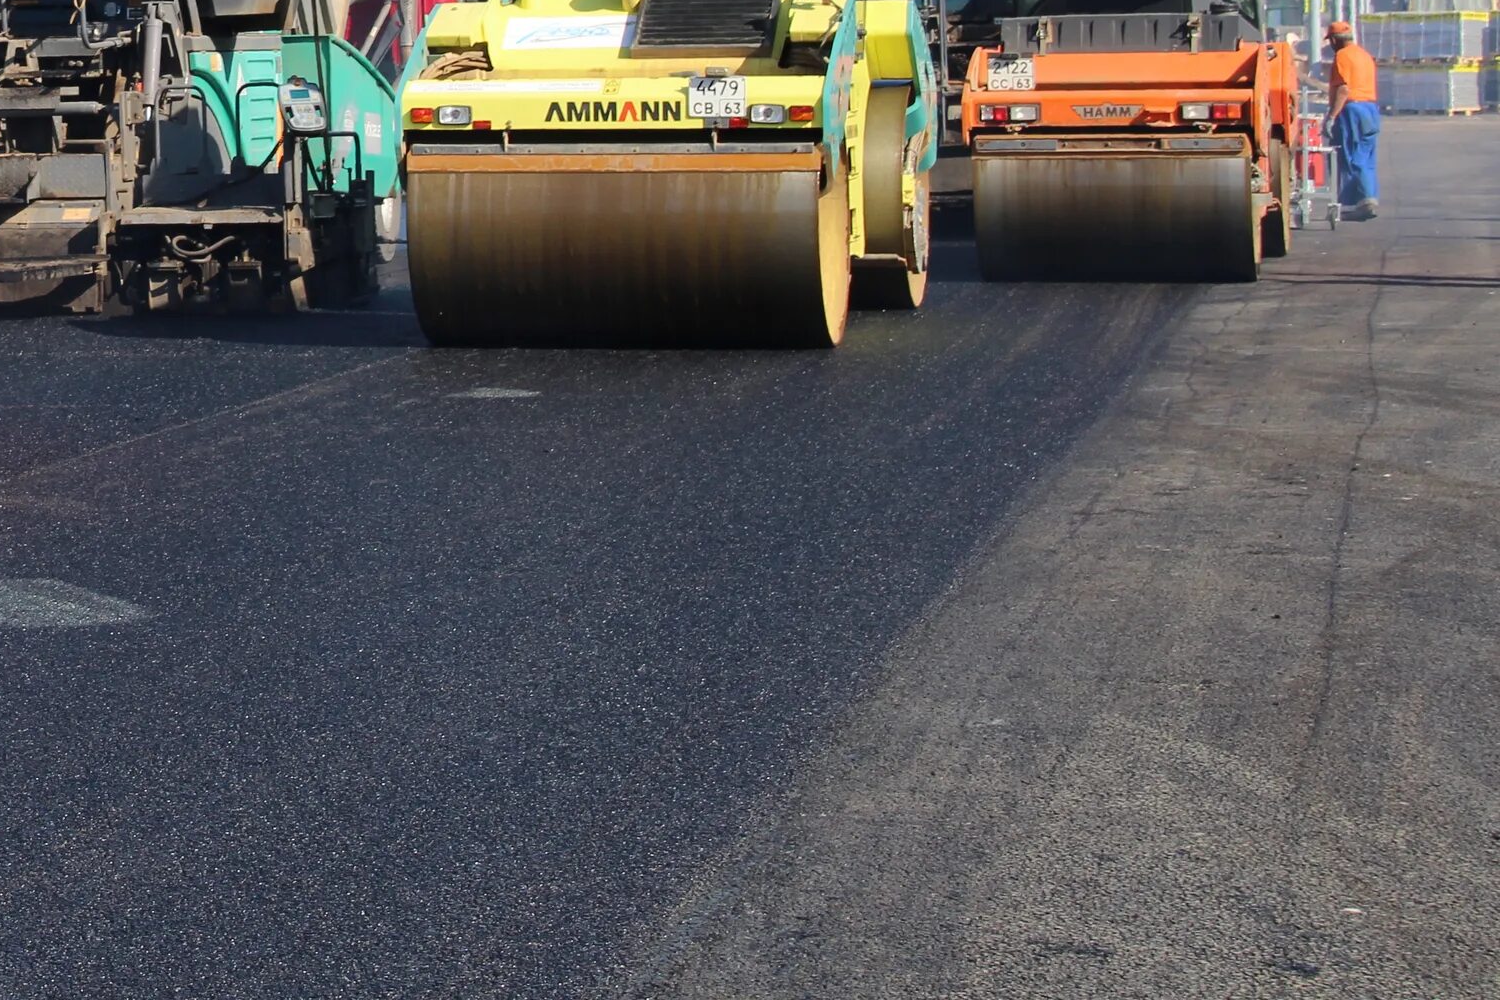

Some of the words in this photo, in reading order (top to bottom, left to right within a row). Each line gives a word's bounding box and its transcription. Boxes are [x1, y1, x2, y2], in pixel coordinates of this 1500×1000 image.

[992, 61, 1029, 75] 2122
[695, 80, 739, 96] 4479
[1016, 78, 1031, 89] 63
[545, 101, 682, 122] AMMANN
[724, 102, 741, 115] 63
[1083, 106, 1132, 118] HAMM
